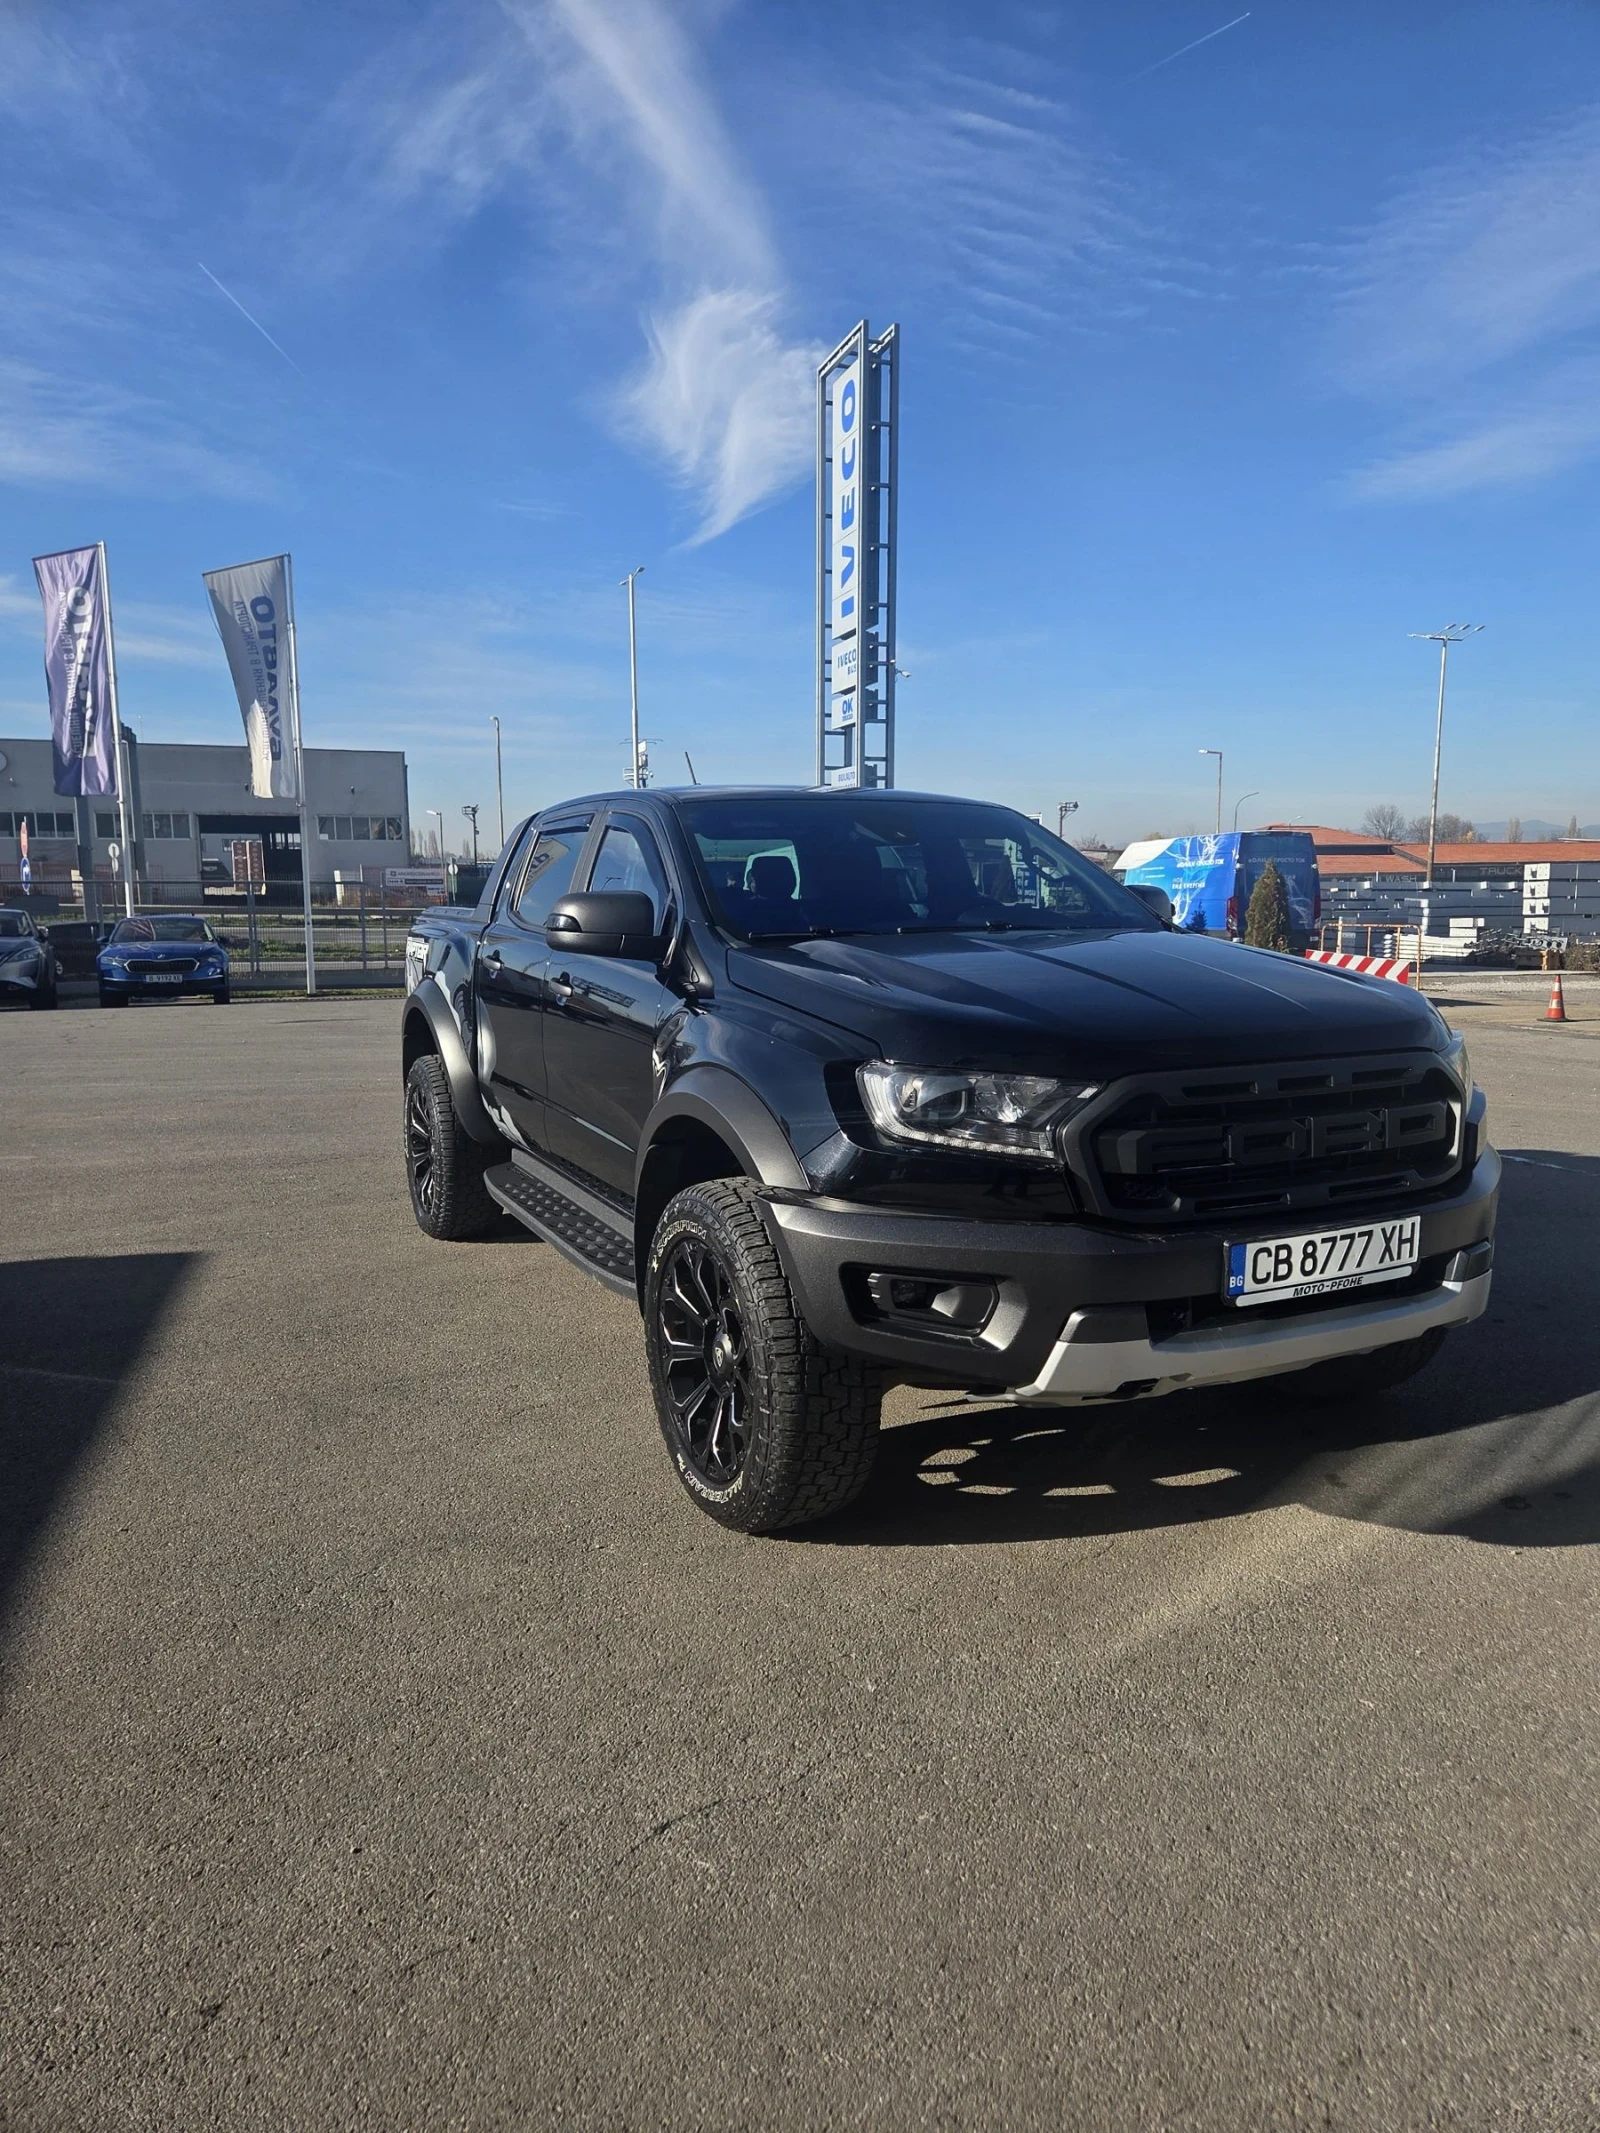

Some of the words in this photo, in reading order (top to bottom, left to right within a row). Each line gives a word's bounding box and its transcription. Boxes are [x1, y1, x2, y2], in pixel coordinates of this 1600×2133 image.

[841, 379, 856, 619] IVECO
[837, 649, 857, 668] IVECO
[842, 697, 854, 714] OK
[1385, 875, 1417, 883] WASH
[1479, 867, 1524, 876] TRUCK
[1115, 1101, 1447, 1174] FORD
[656, 1219, 707, 1258] SCORPION
[1251, 1243, 1293, 1285] CB
[1300, 1229, 1374, 1277] 8777
[1378, 1221, 1416, 1264] XH
[1229, 1275, 1244, 1288] BG
[1292, 1276, 1364, 1297] MOTO-PFOHE
